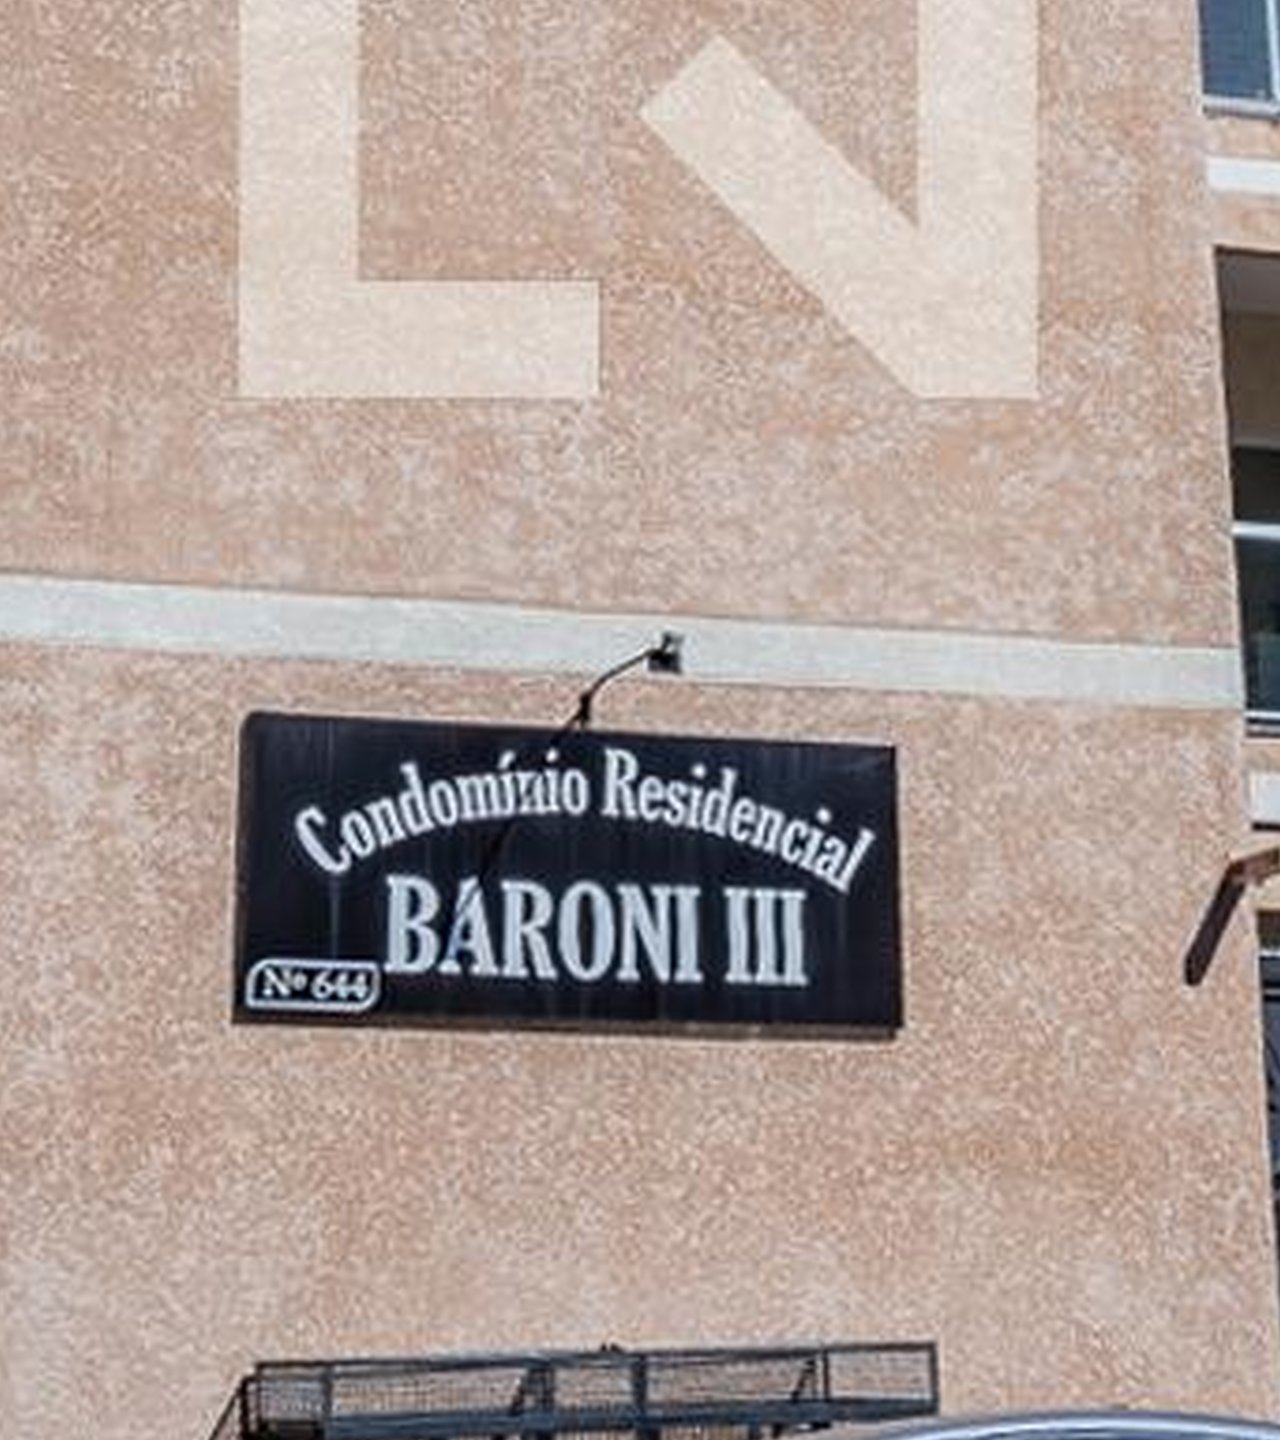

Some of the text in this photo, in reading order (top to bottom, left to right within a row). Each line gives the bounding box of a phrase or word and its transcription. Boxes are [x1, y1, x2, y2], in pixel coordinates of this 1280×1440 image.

[295, 748, 876, 894] Condomínio Residencial
[310, 968, 369, 999] 644
[384, 874, 809, 986] BARONI III
